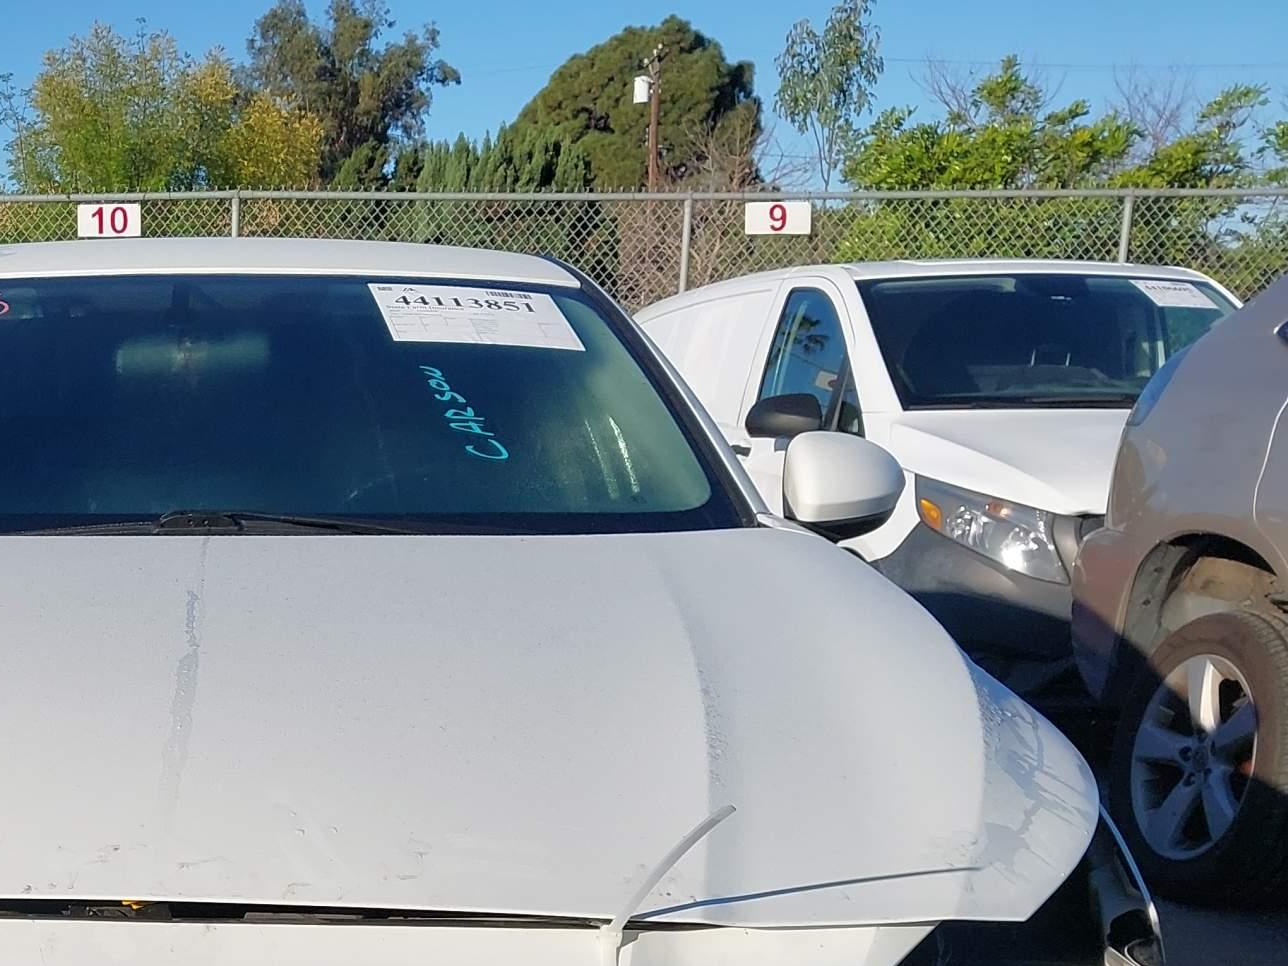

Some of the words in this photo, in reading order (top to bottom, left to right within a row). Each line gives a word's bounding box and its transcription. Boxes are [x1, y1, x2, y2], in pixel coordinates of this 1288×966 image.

[91, 206, 128, 234] 10
[769, 204, 787, 231] 9
[395, 295, 536, 313] 44113851
[419, 365, 509, 459] CARSON
